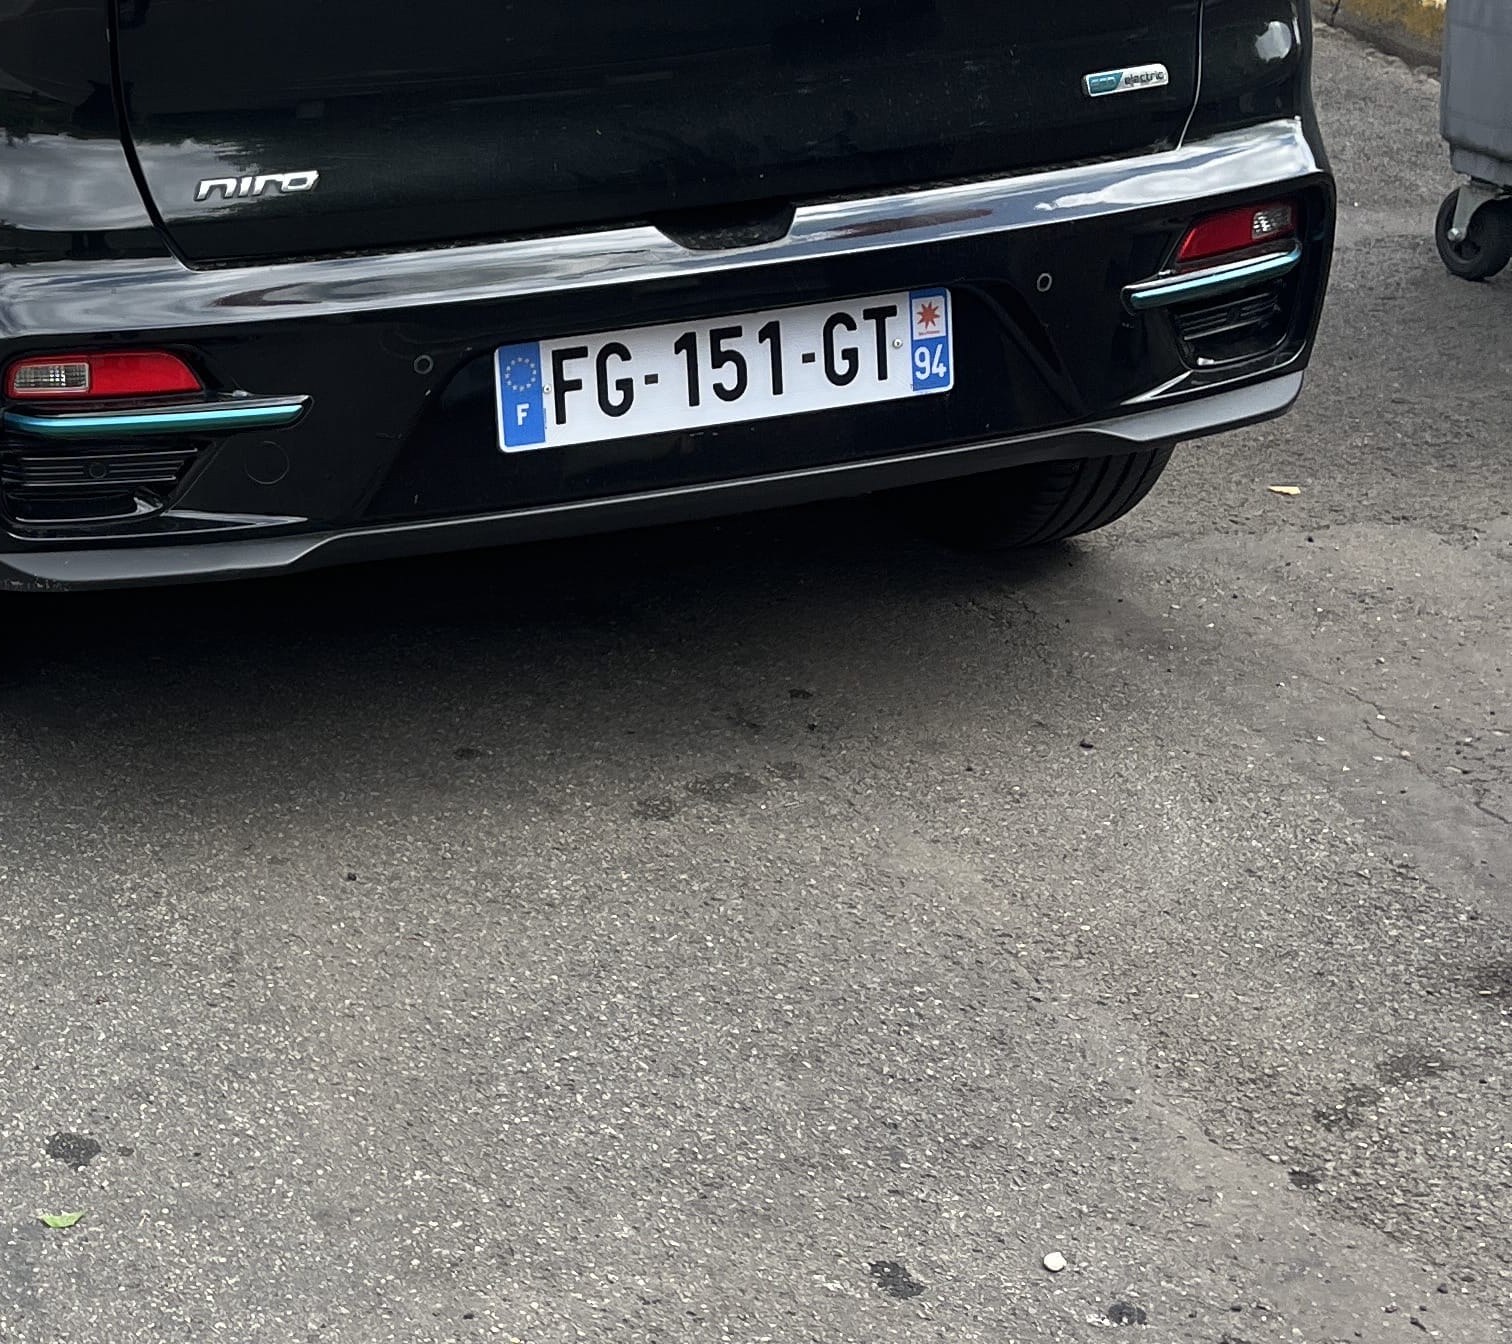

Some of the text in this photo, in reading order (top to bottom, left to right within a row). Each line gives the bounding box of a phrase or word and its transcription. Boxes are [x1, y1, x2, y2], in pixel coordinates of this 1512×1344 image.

[551, 304, 898, 425] FG-151-GT
[914, 344, 947, 380] 94
[516, 403, 530, 426] F
